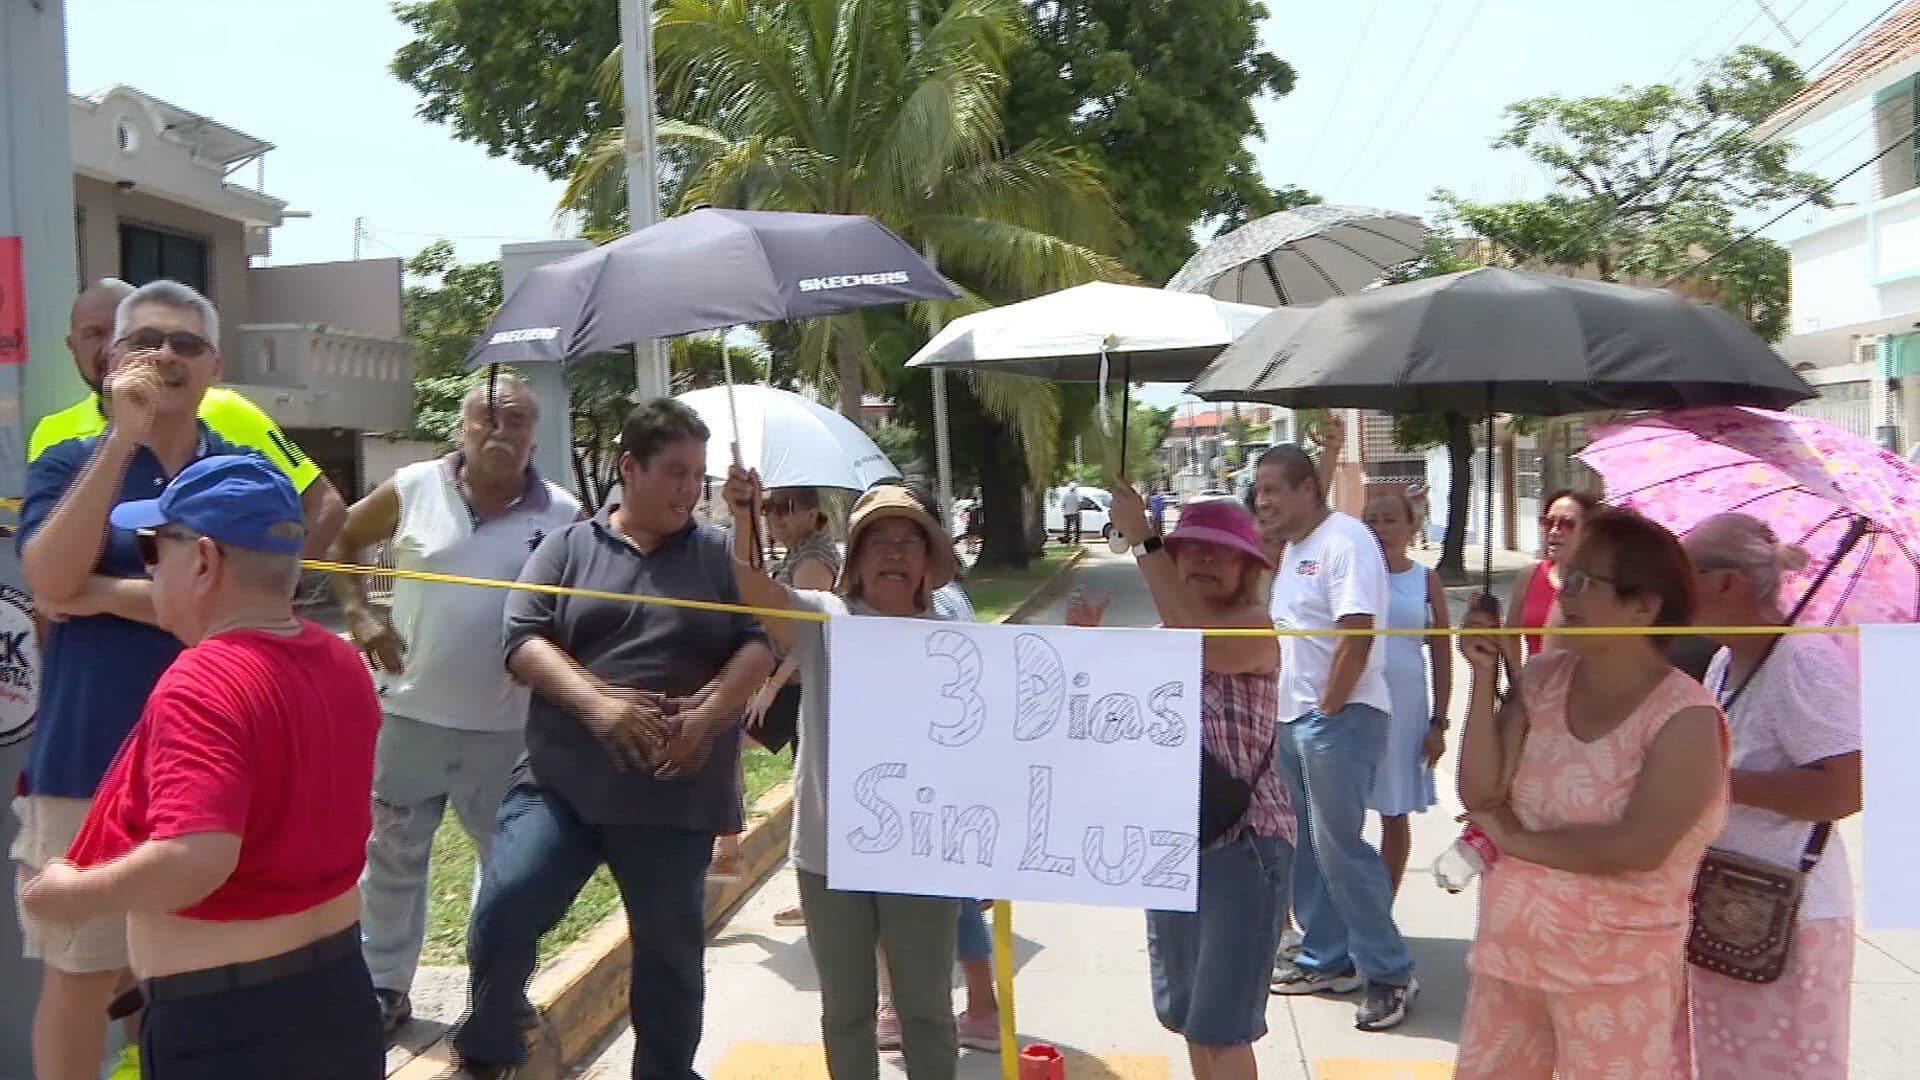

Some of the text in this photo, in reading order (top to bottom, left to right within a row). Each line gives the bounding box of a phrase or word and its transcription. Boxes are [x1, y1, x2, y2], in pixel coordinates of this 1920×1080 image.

[799, 271, 909, 291] SKECHERS
[925, 629, 1188, 747] 3 Dias
[846, 762, 1199, 891] Sin Luz
